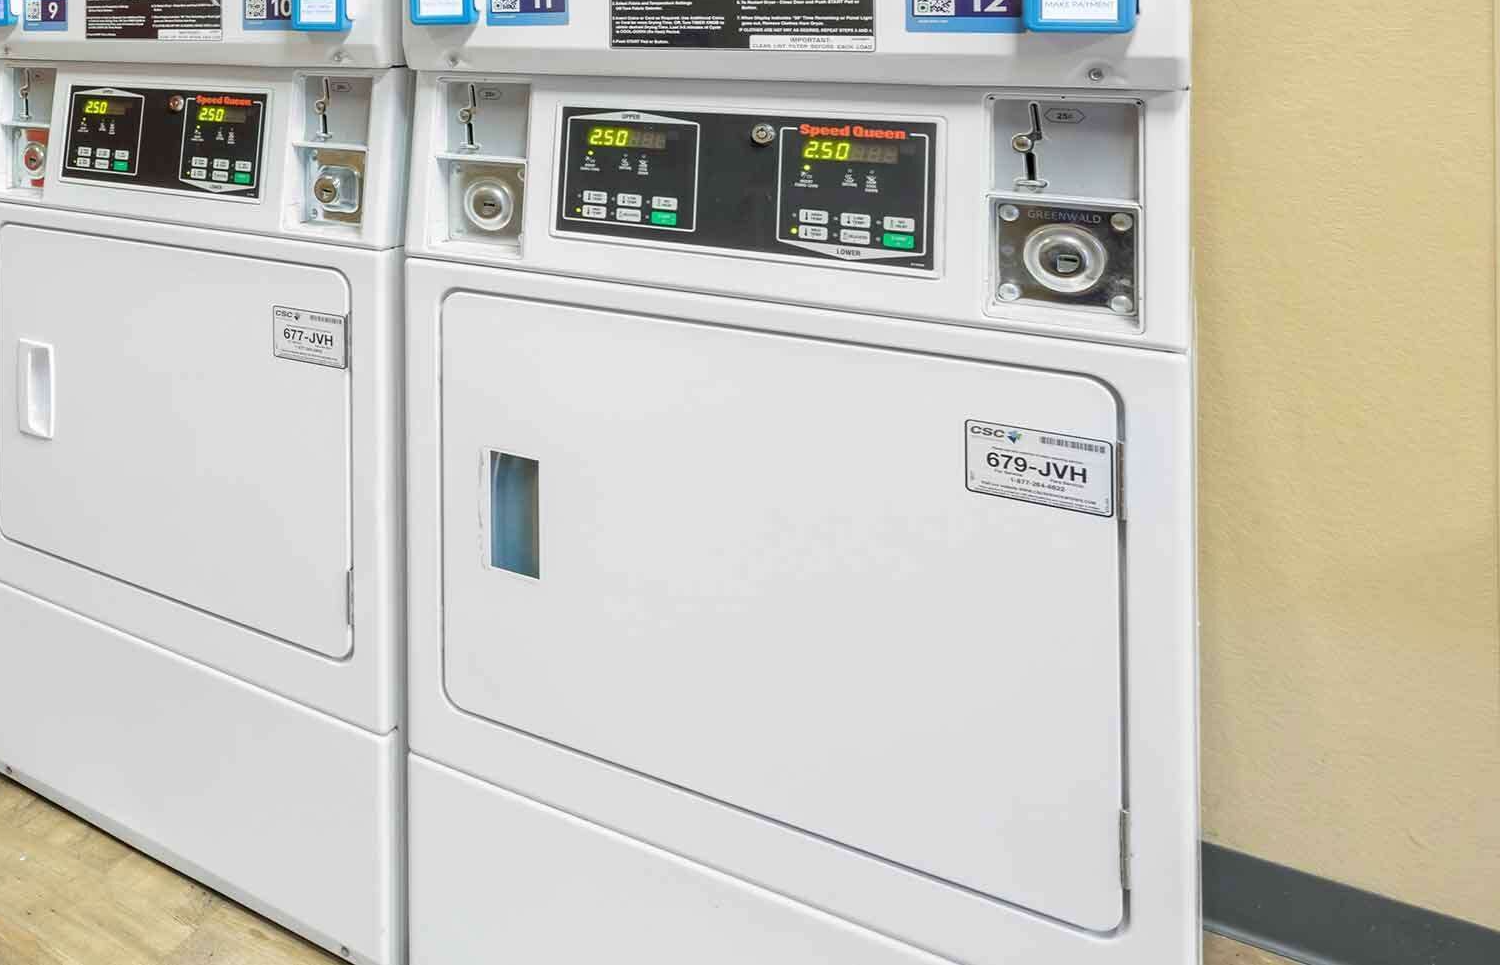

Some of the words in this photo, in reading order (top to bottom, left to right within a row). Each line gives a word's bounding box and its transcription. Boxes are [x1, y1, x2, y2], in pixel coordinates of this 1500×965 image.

[48, 2, 58, 19] 9
[196, 95, 223, 105] Speed
[224, 97, 252, 107] Queen
[589, 128, 628, 147] 2.50
[799, 123, 851, 138] Speed
[852, 125, 906, 140] Queen
[804, 140, 850, 160] 2.50
[1027, 209, 1102, 224] GREENWALD
[836, 248, 862, 256] LOWER
[275, 310, 293, 318] CSC
[283, 328, 333, 346] 677-JVH
[970, 425, 1005, 439] CSC
[986, 452, 1088, 484] 679-JVH
